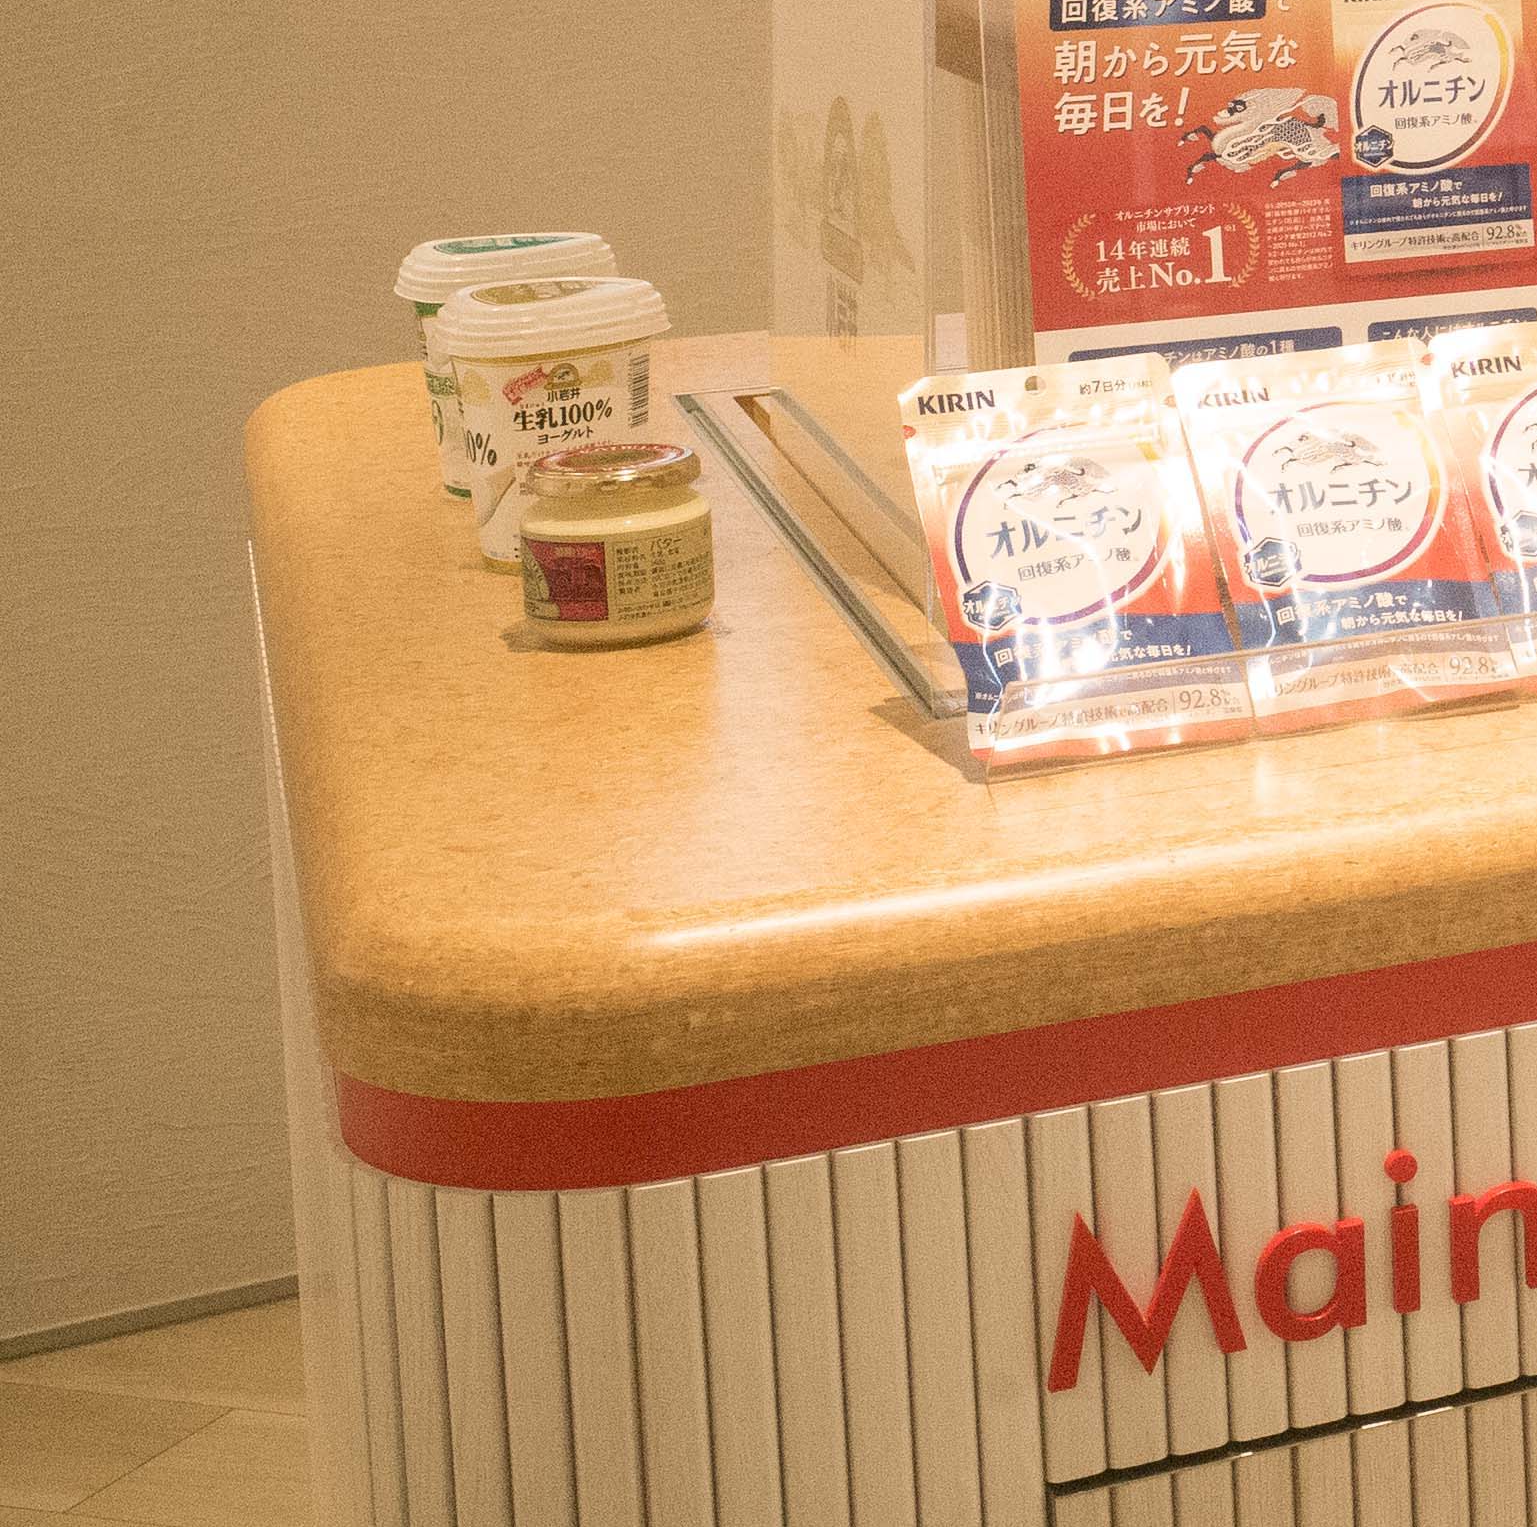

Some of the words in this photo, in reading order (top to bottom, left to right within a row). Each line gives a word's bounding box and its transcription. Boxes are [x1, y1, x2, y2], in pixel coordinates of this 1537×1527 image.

[1053, 30, 1299, 85] 朝から元気な
[1378, 75, 1487, 110] オルニチン
[1053, 86, 1191, 136] 毎日を!
[1115, 204, 1216, 222] オルニチンサプリメント
[1096, 237, 1191, 264] 14年連続
[1450, 354, 1523, 378] KIRIN
[546, 387, 581, 403] 小岩井
[917, 389, 996, 416] KIRIN
[512, 397, 613, 433] 生乳100%
[536, 425, 594, 445] ヨーグルト
